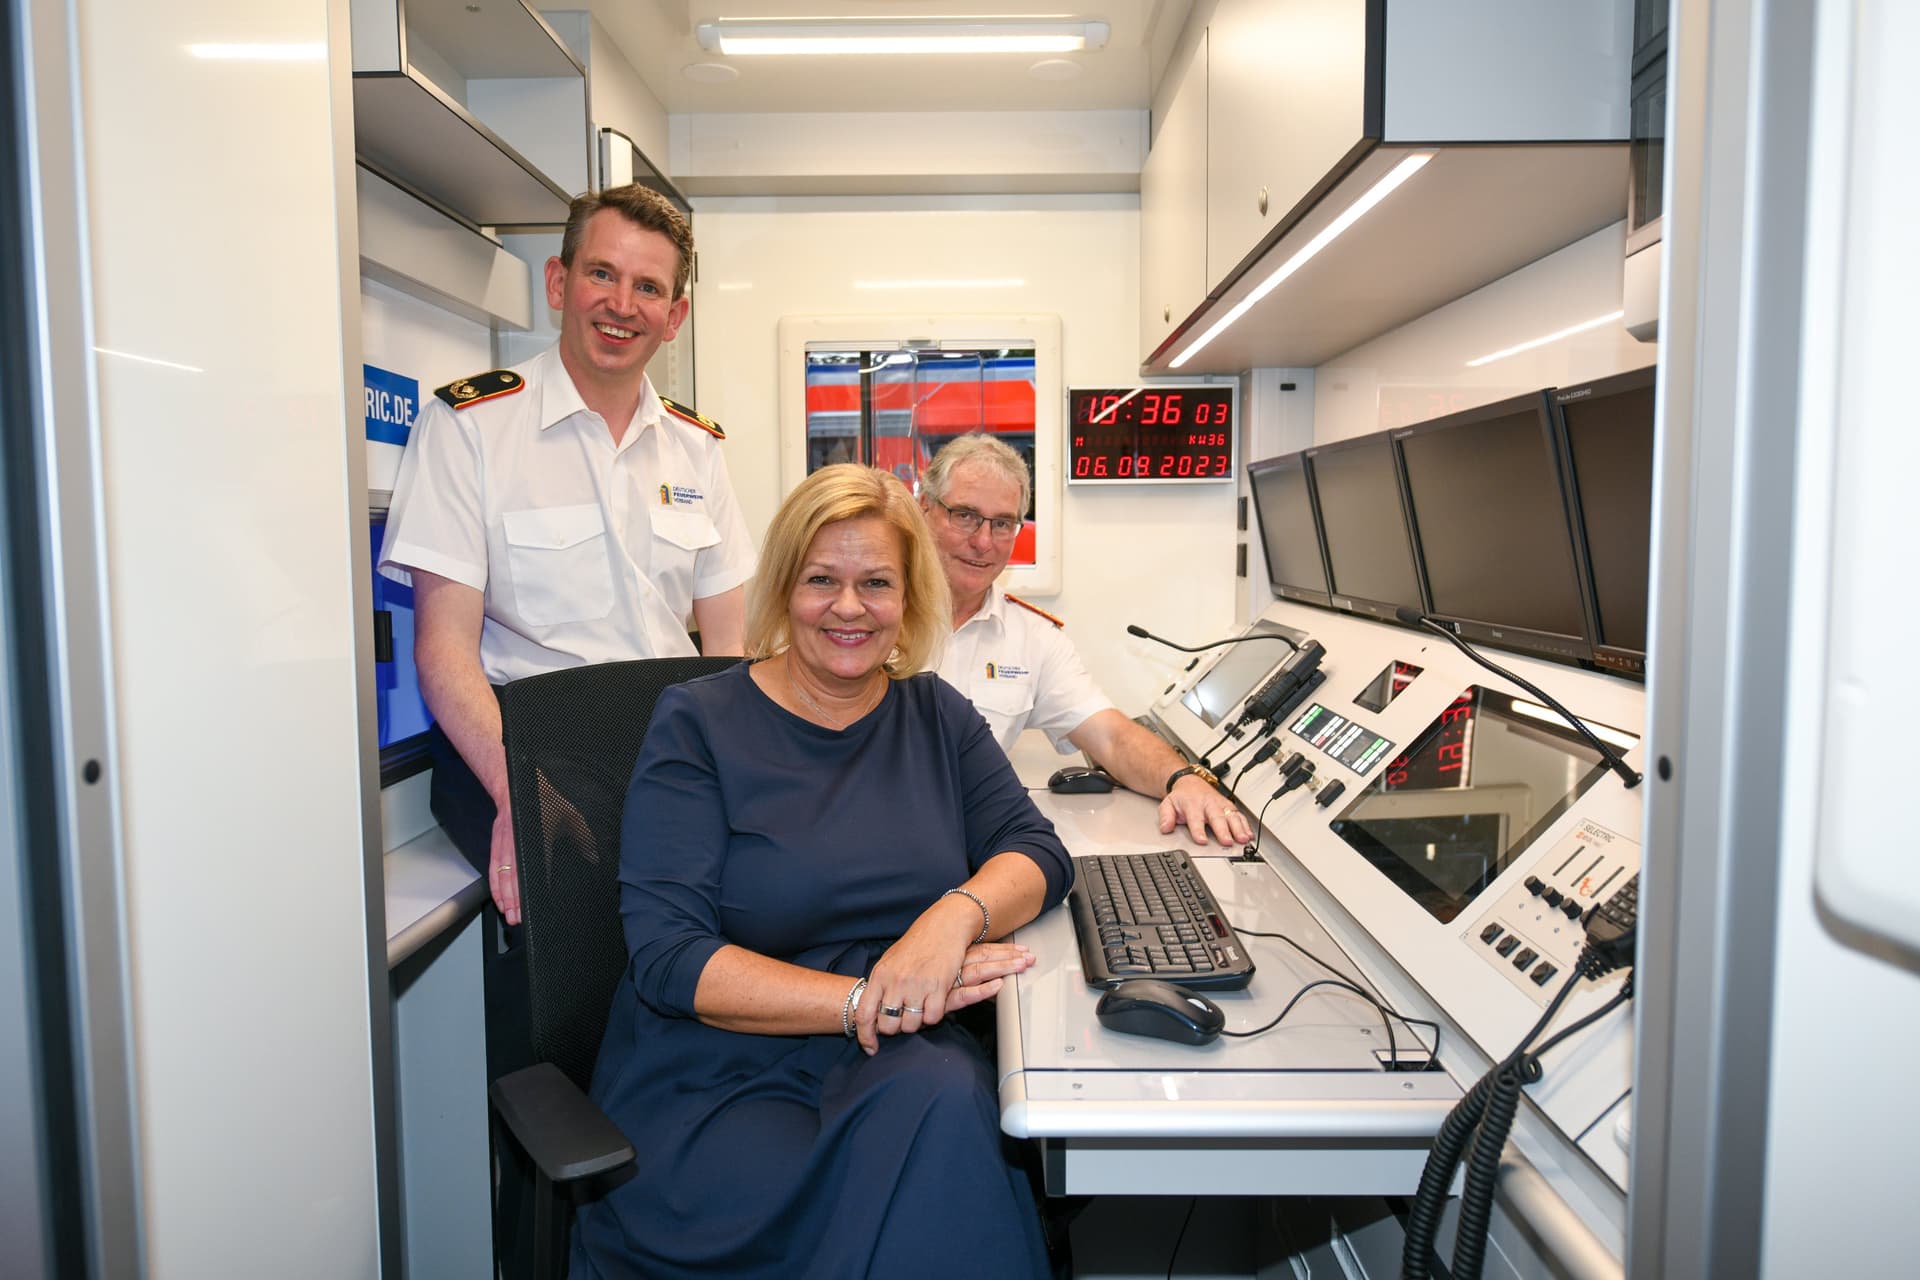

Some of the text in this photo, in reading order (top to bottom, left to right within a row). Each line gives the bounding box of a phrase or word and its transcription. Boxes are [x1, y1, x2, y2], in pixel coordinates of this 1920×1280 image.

[365, 387, 413, 427] RIC.DE
[1195, 403, 1228, 424] 03
[1075, 436, 1084, 446] M
